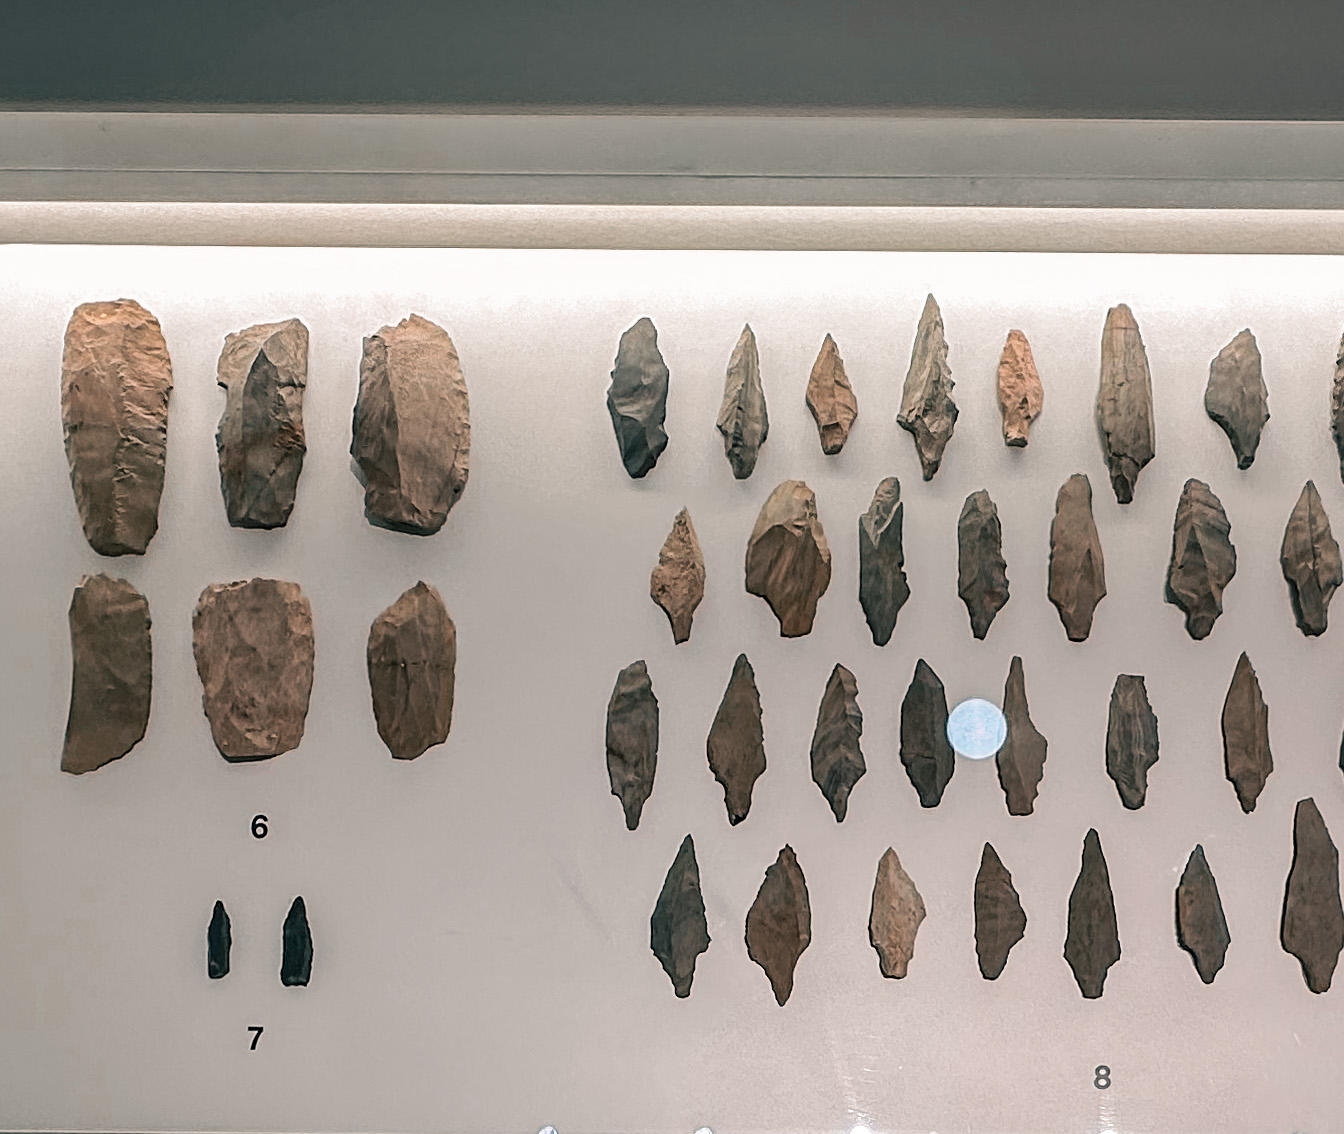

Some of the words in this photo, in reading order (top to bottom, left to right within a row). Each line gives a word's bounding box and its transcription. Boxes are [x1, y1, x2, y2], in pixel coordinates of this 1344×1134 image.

[250, 814, 269, 839] 6
[247, 1026, 264, 1051] 7
[1094, 1065, 1111, 1090] 8
